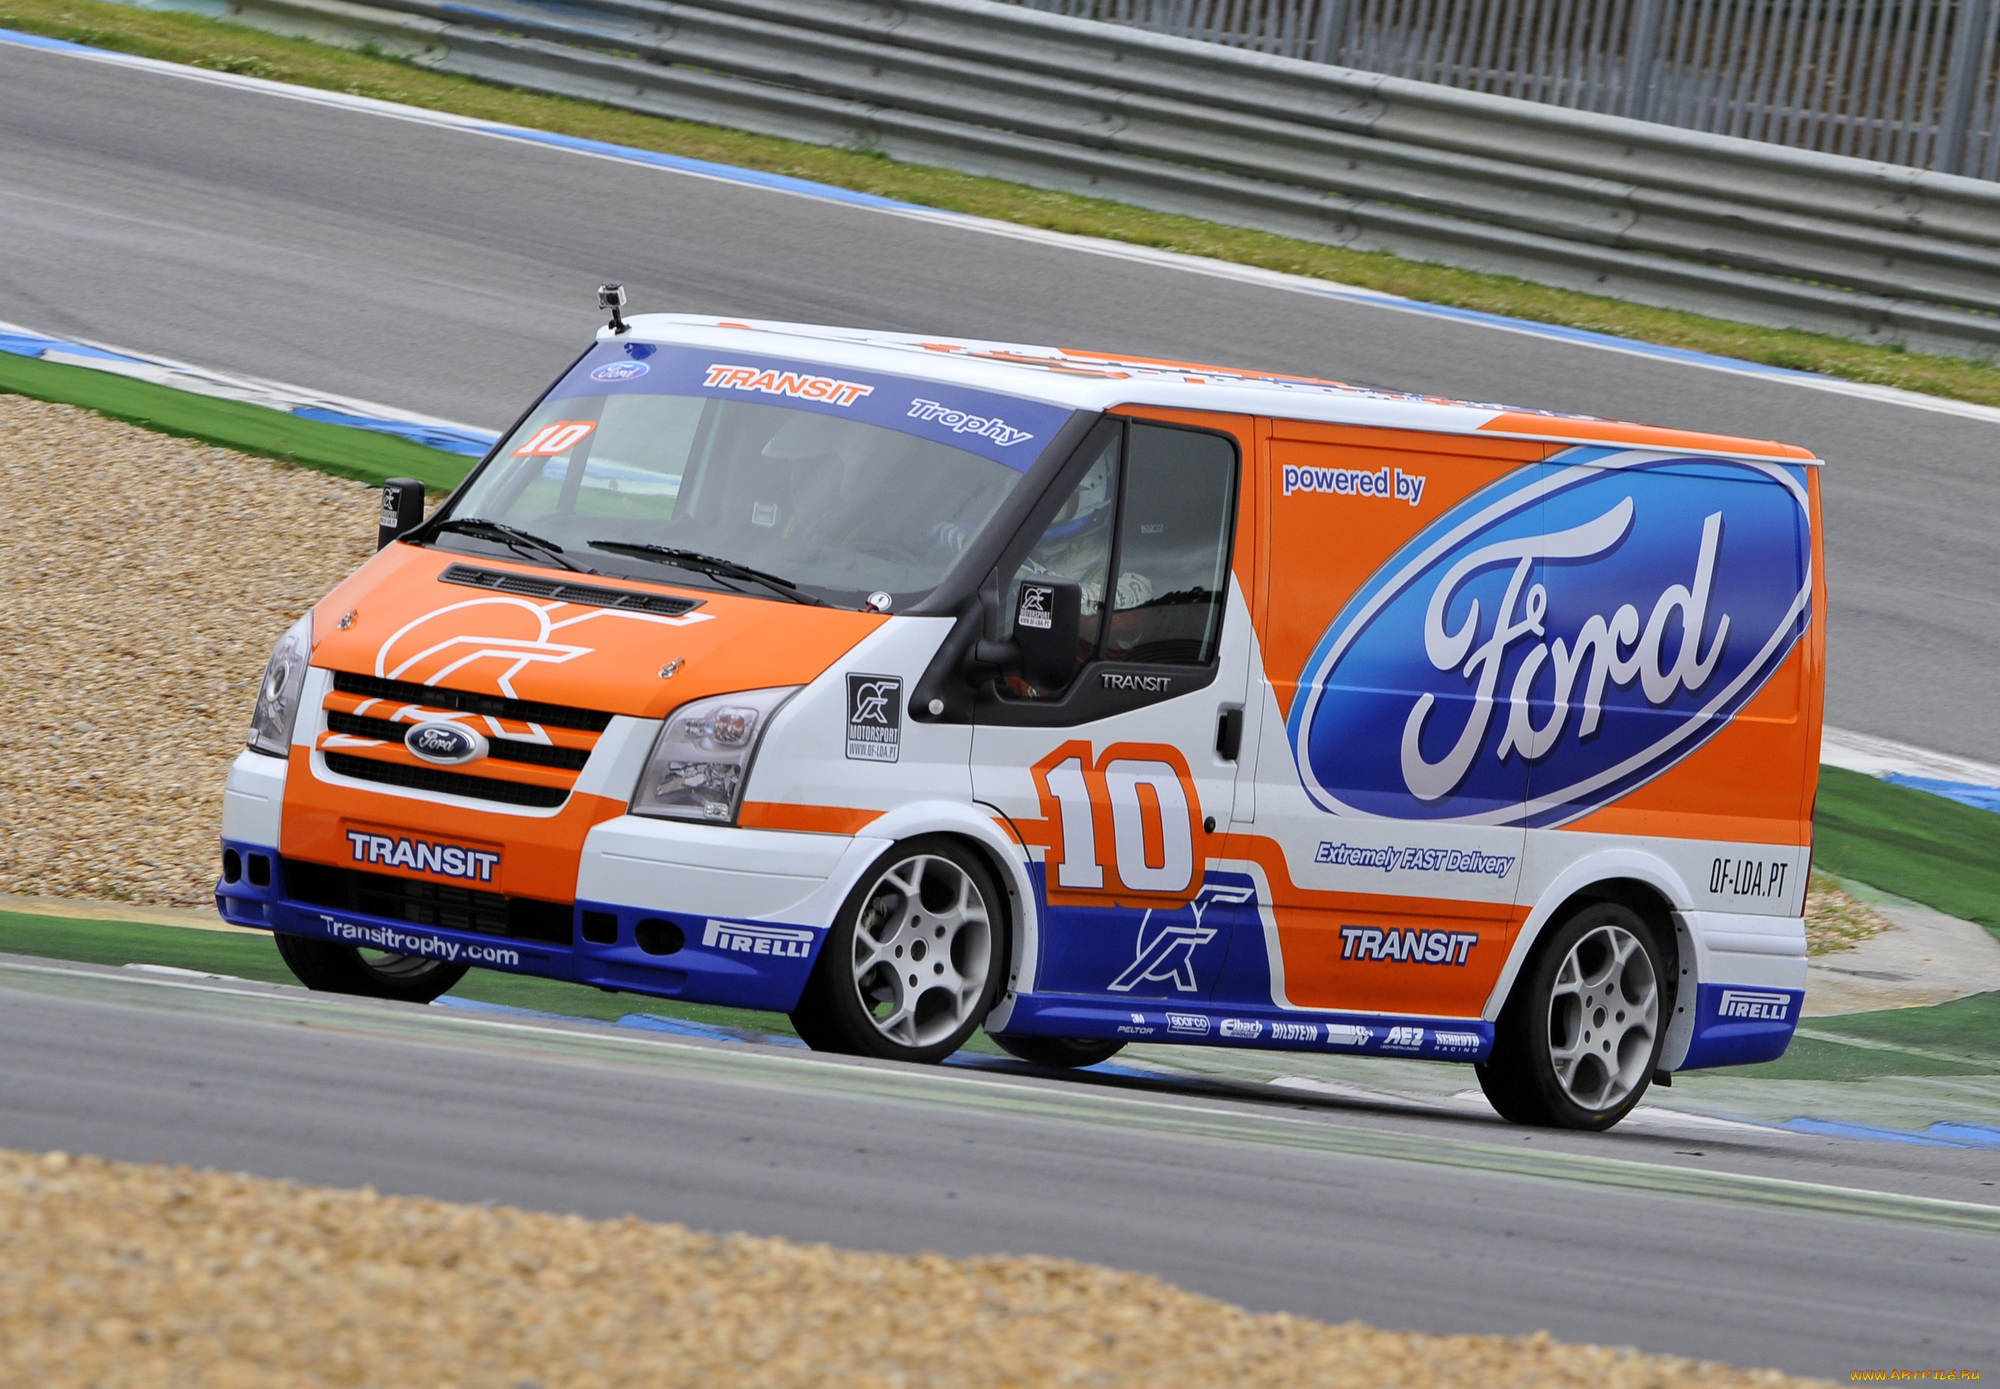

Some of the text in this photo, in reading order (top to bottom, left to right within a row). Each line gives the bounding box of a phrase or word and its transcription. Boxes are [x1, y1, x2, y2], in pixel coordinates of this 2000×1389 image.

[596, 363, 639, 381] Ford
[703, 364, 874, 407] TRANSIT
[515, 422, 594, 457] 10
[907, 398, 1034, 448] Trophy
[1283, 466, 1426, 506] powered by
[1401, 496, 1730, 800] Ford
[1102, 673, 1171, 693] TRANSIT
[418, 730, 458, 753] Ford
[850, 724, 898, 744] MOTORSPORT
[1045, 757, 1194, 892] 10
[347, 832, 498, 880] TRANSIT
[1315, 841, 1515, 878] Extremely FAST Delivery
[1709, 857, 1789, 898] QF-LDA.PT
[320, 914, 519, 966] Transitrophy.com
[702, 919, 815, 958] PIRELLI
[1340, 926, 1478, 966] TRANSIT
[1171, 1016, 1207, 1028] sparco
[1719, 989, 1790, 1021] PIRELLI
[1117, 1026, 1153, 1034] PELTOR
[1220, 1018, 1262, 1038] Eibach
[1272, 1023, 1318, 1041] BILSTEIN
[1384, 1026, 1424, 1045] AEZ
